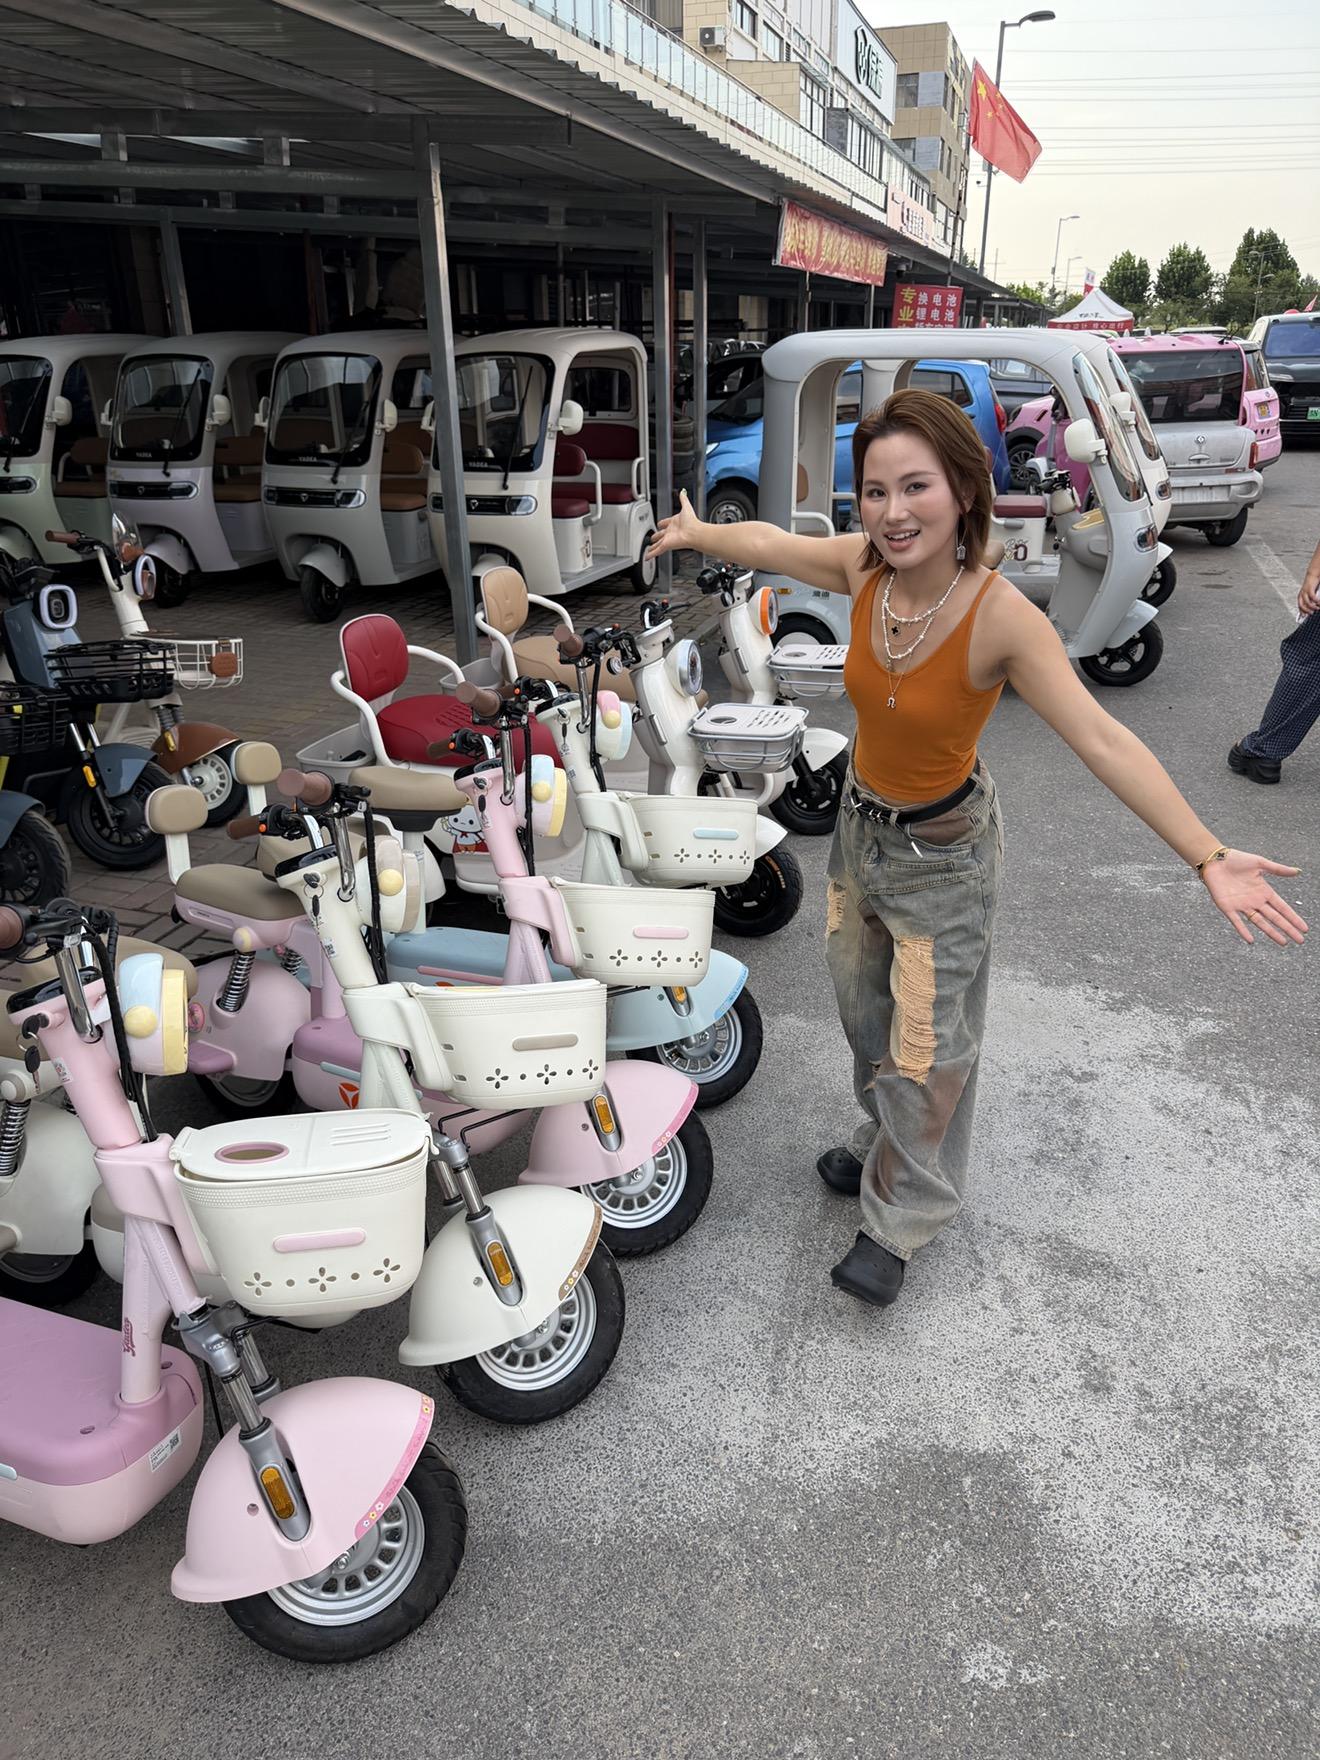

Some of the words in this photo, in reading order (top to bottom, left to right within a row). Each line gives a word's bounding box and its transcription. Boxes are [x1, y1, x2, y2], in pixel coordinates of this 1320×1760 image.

[918, 291, 957, 307] 换电池
[898, 287, 917, 328] 专业
[916, 307, 955, 322] 锂电池
